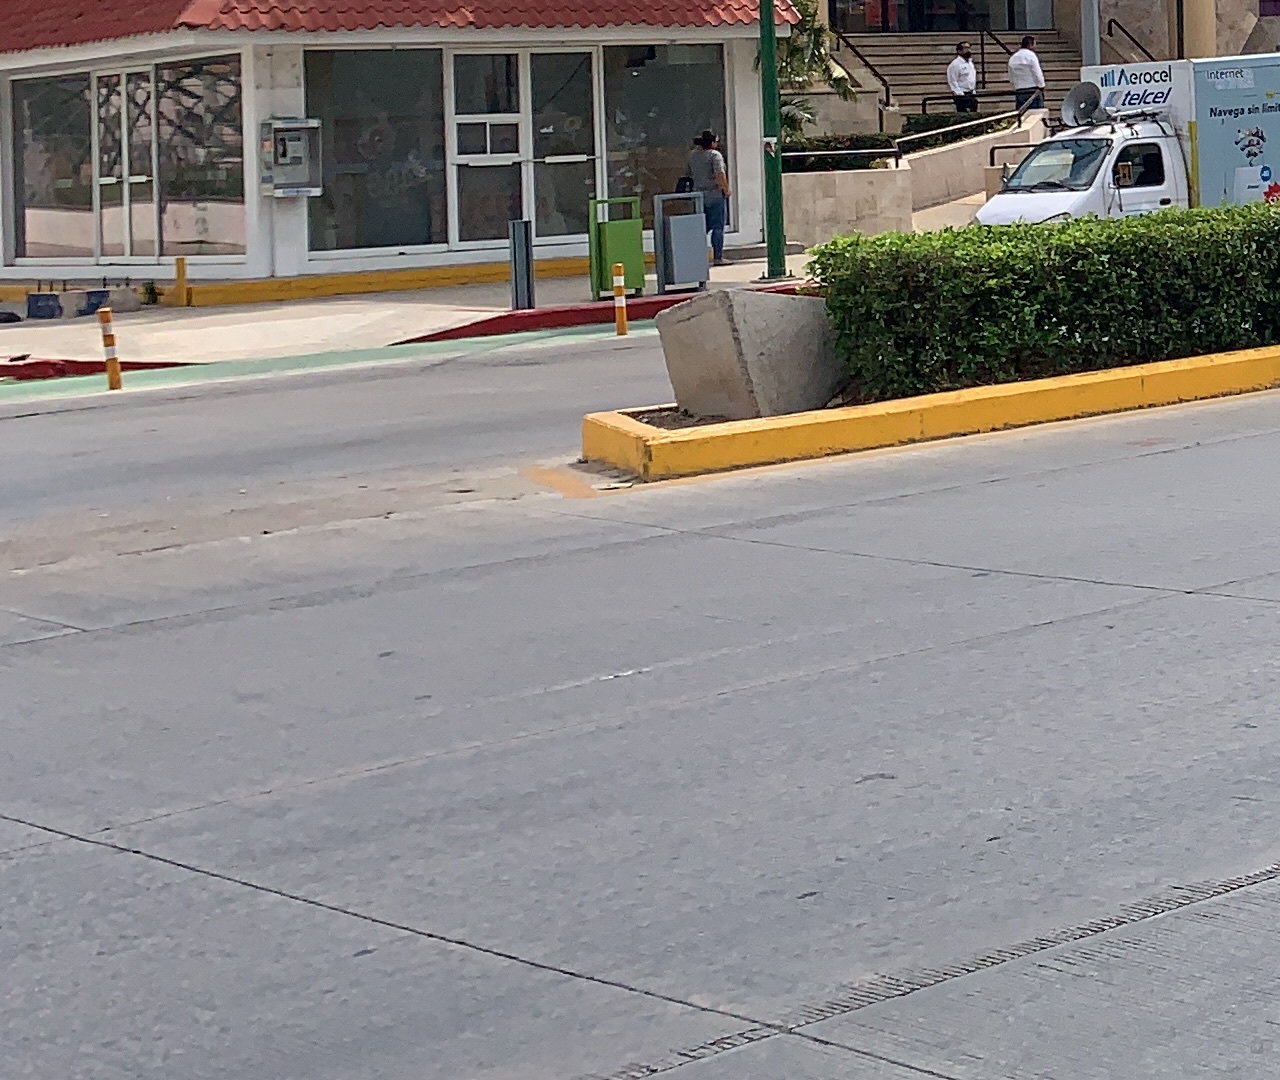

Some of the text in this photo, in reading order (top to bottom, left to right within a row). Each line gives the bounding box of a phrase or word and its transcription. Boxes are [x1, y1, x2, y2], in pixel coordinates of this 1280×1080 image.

[1206, 69, 1244, 80] Internet
[1121, 86, 1172, 107] telcel
[1209, 104, 1245, 119] Navega
[1247, 103, 1261, 115] sin
